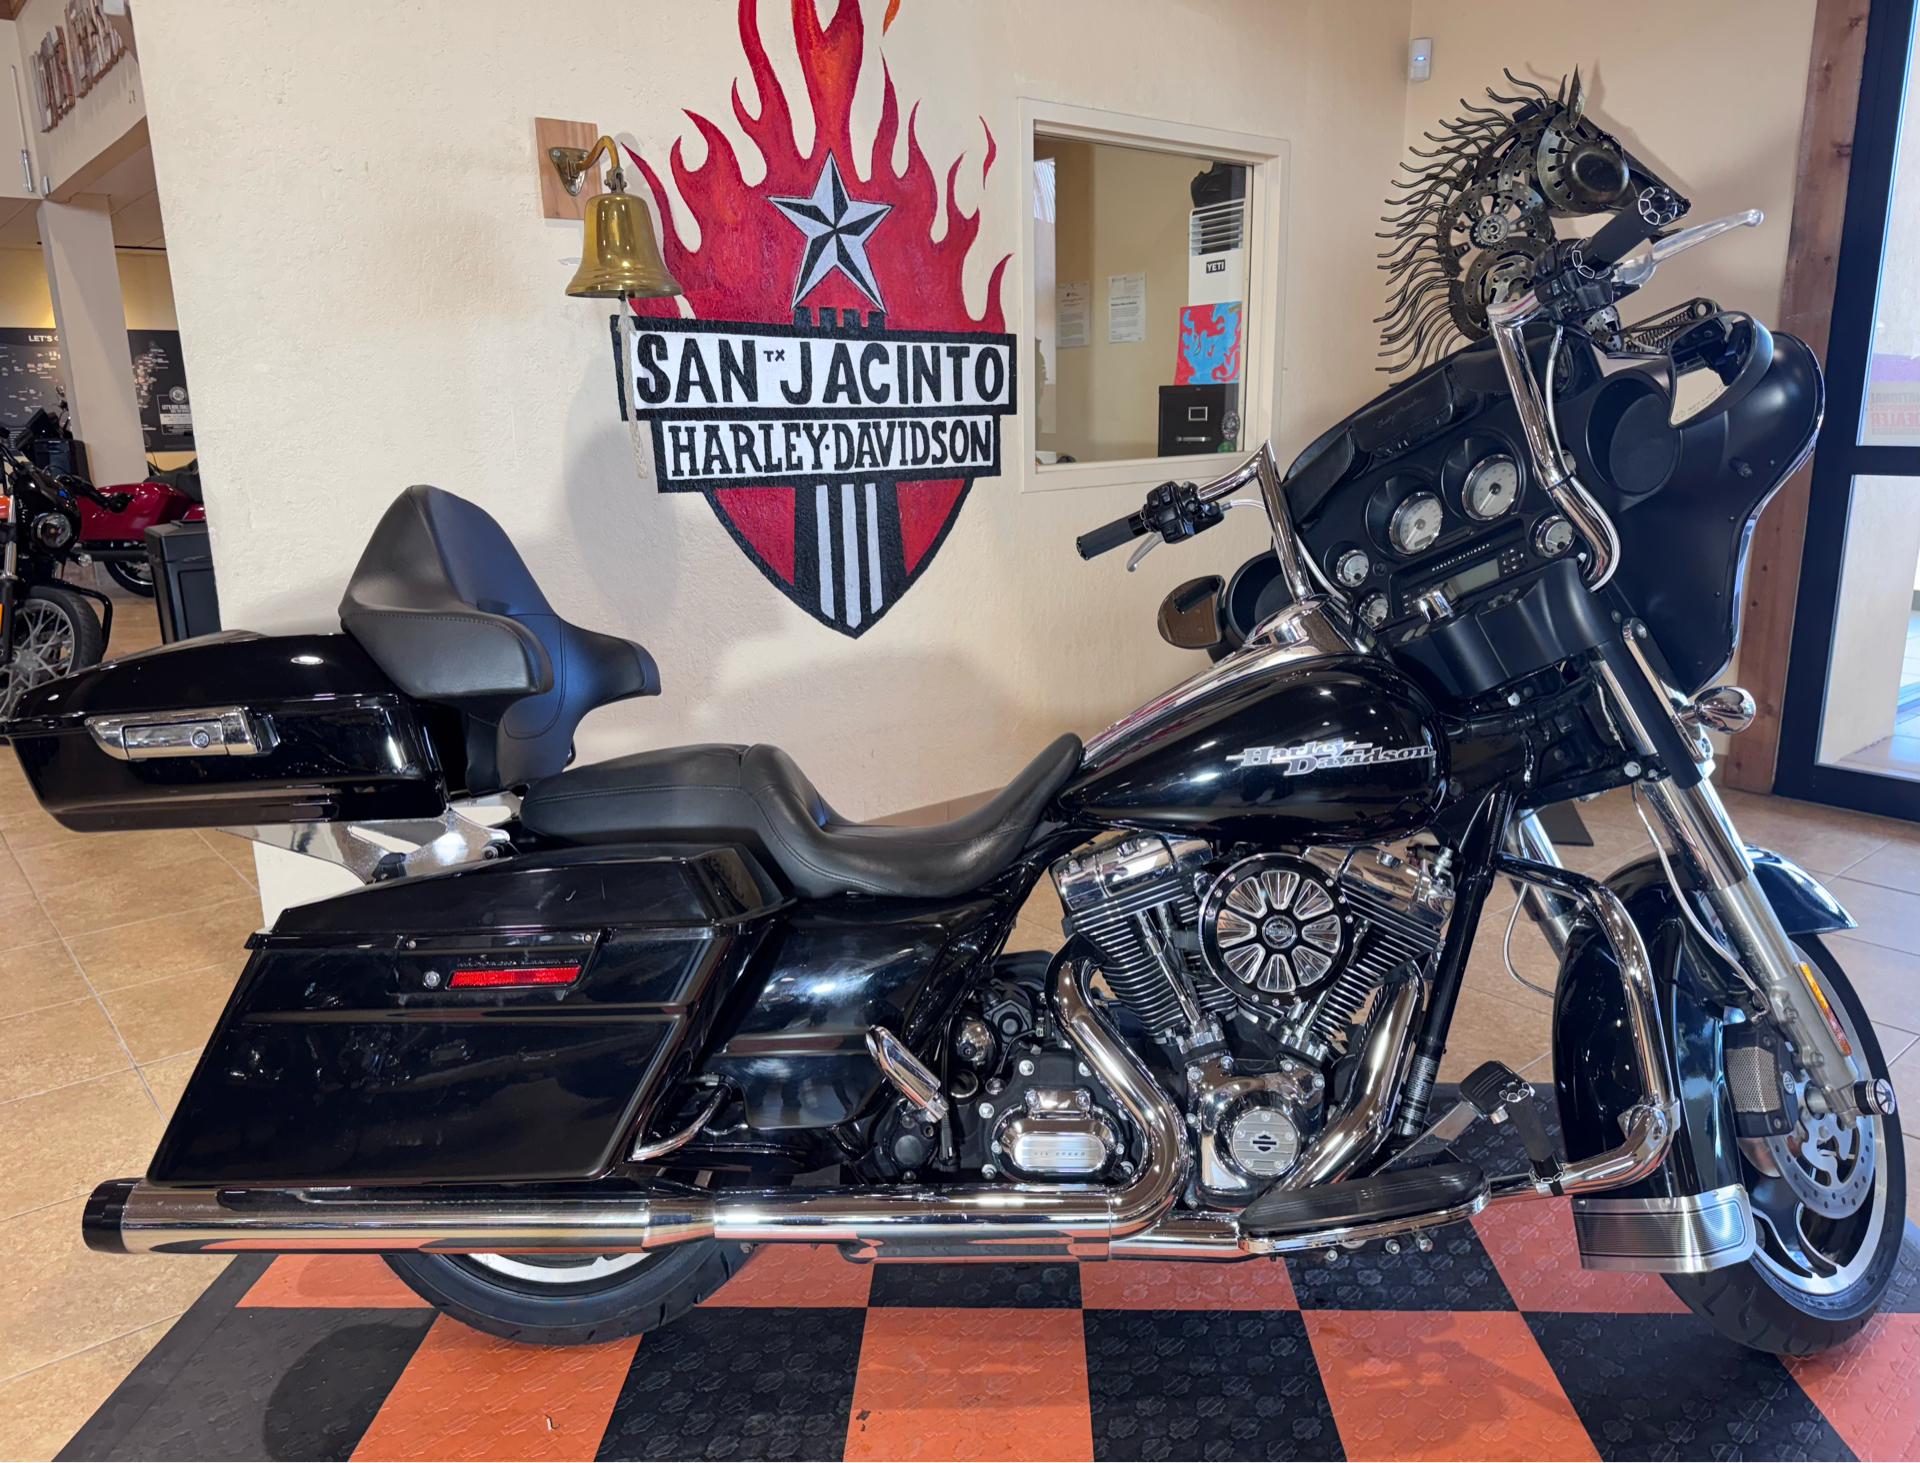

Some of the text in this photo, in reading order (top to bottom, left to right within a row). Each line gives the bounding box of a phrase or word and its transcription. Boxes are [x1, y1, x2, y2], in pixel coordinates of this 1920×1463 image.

[1207, 261, 1225, 272] YETI
[28, 334, 53, 342] LET'S
[636, 333, 1004, 405] SAN TX JACINTO
